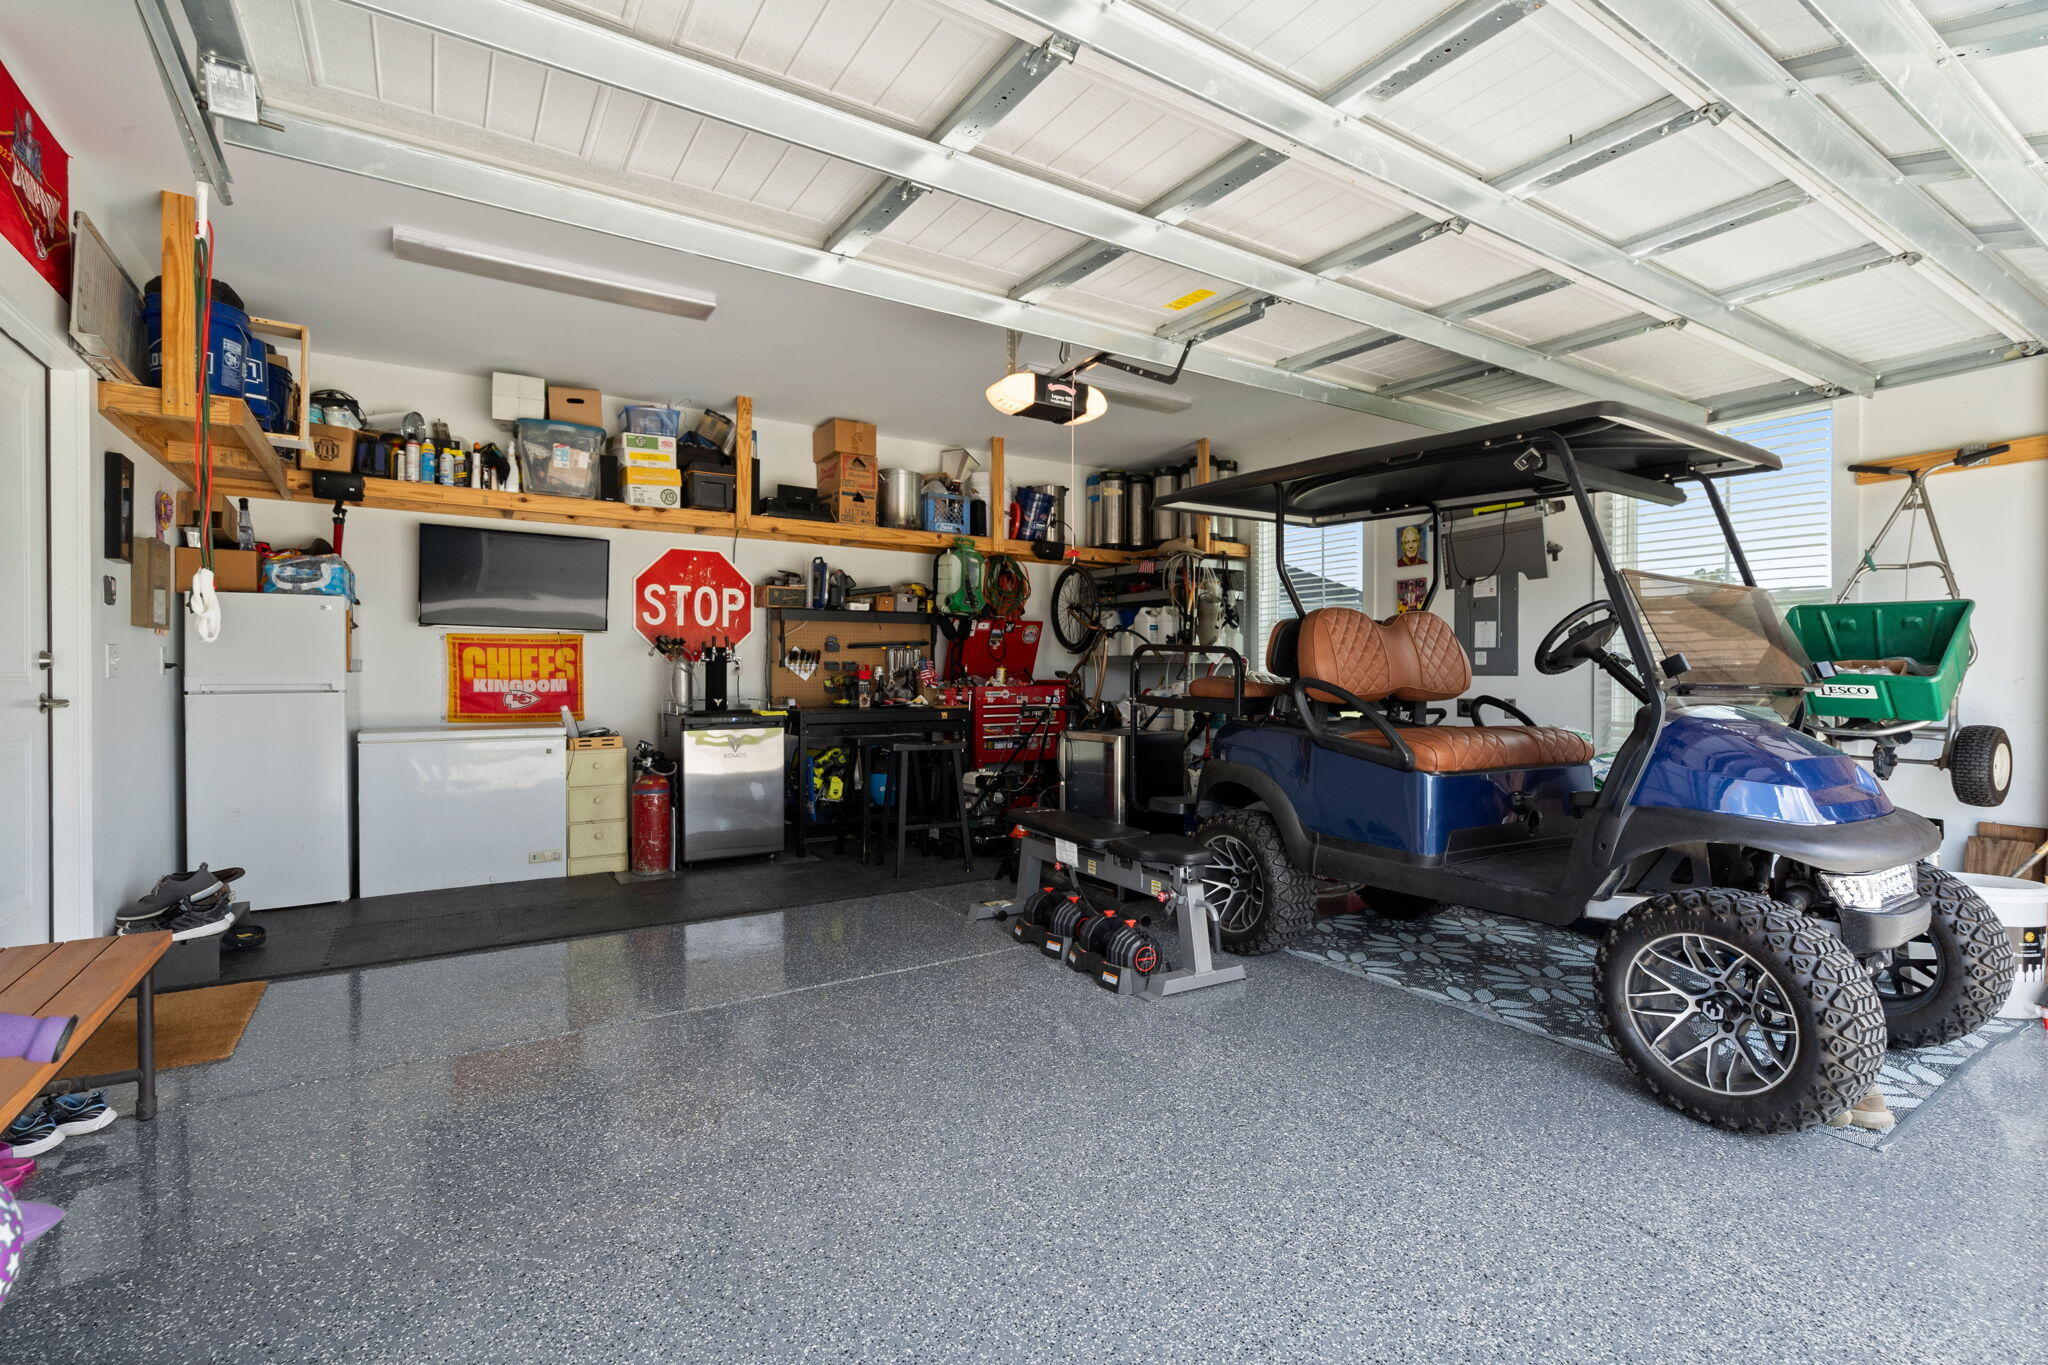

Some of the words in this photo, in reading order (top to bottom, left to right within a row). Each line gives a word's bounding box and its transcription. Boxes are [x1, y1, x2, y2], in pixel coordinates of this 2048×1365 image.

[844, 507, 871, 518] ULTRA
[642, 584, 745, 628] STOP
[462, 646, 576, 680] CHIEFS
[473, 679, 568, 693] KINGDOM
[1821, 686, 1870, 696] LESCO
